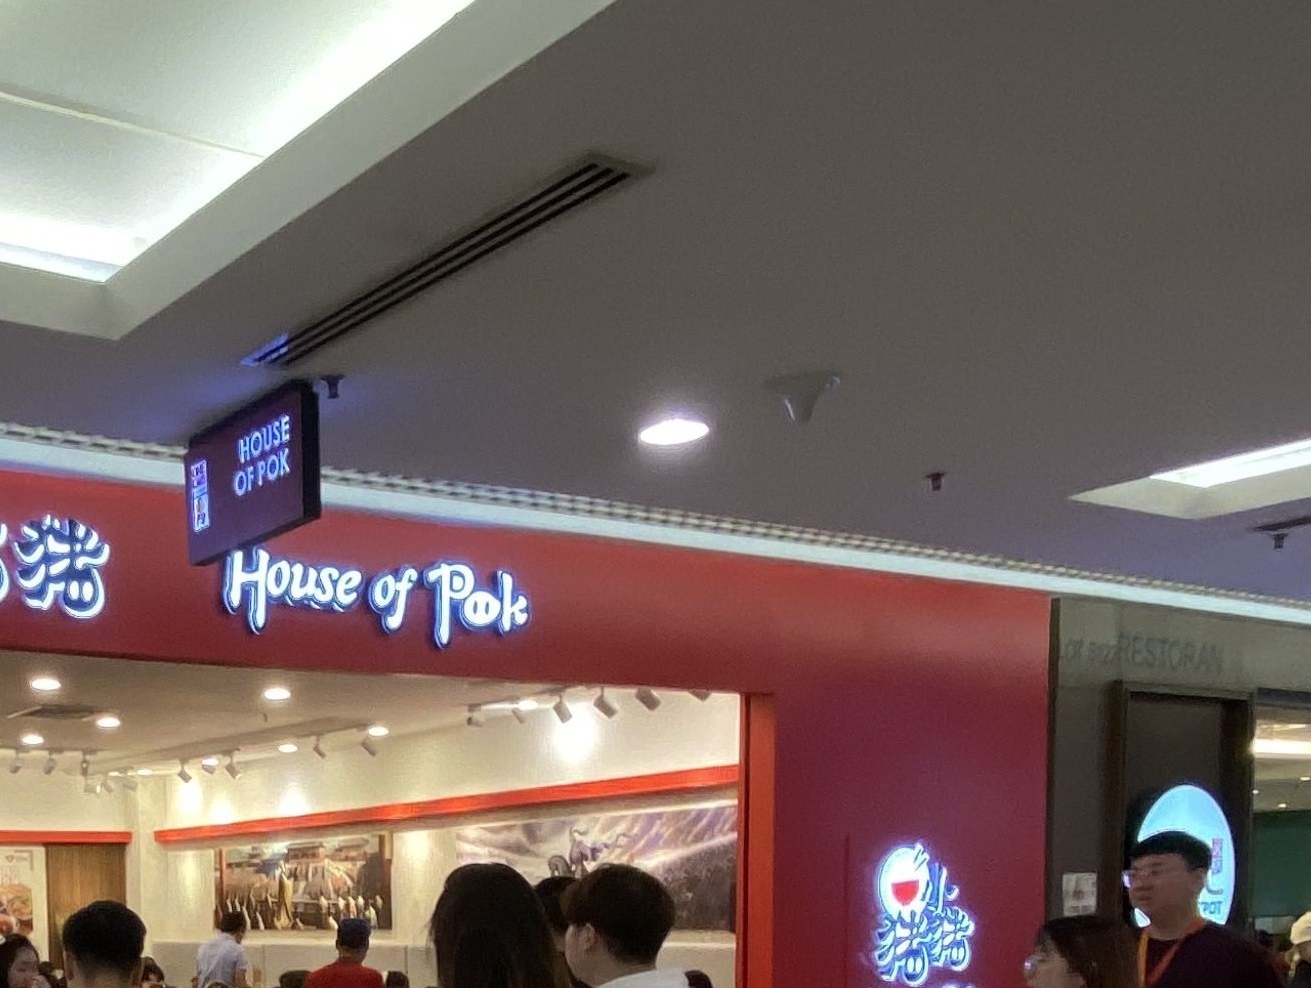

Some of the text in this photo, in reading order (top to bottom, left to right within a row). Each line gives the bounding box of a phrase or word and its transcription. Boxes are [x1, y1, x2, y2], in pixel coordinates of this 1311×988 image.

[239, 414, 290, 464] HOUSE
[234, 466, 255, 496] OF
[257, 447, 290, 486] POK
[224, 546, 530, 650] House of Pok
